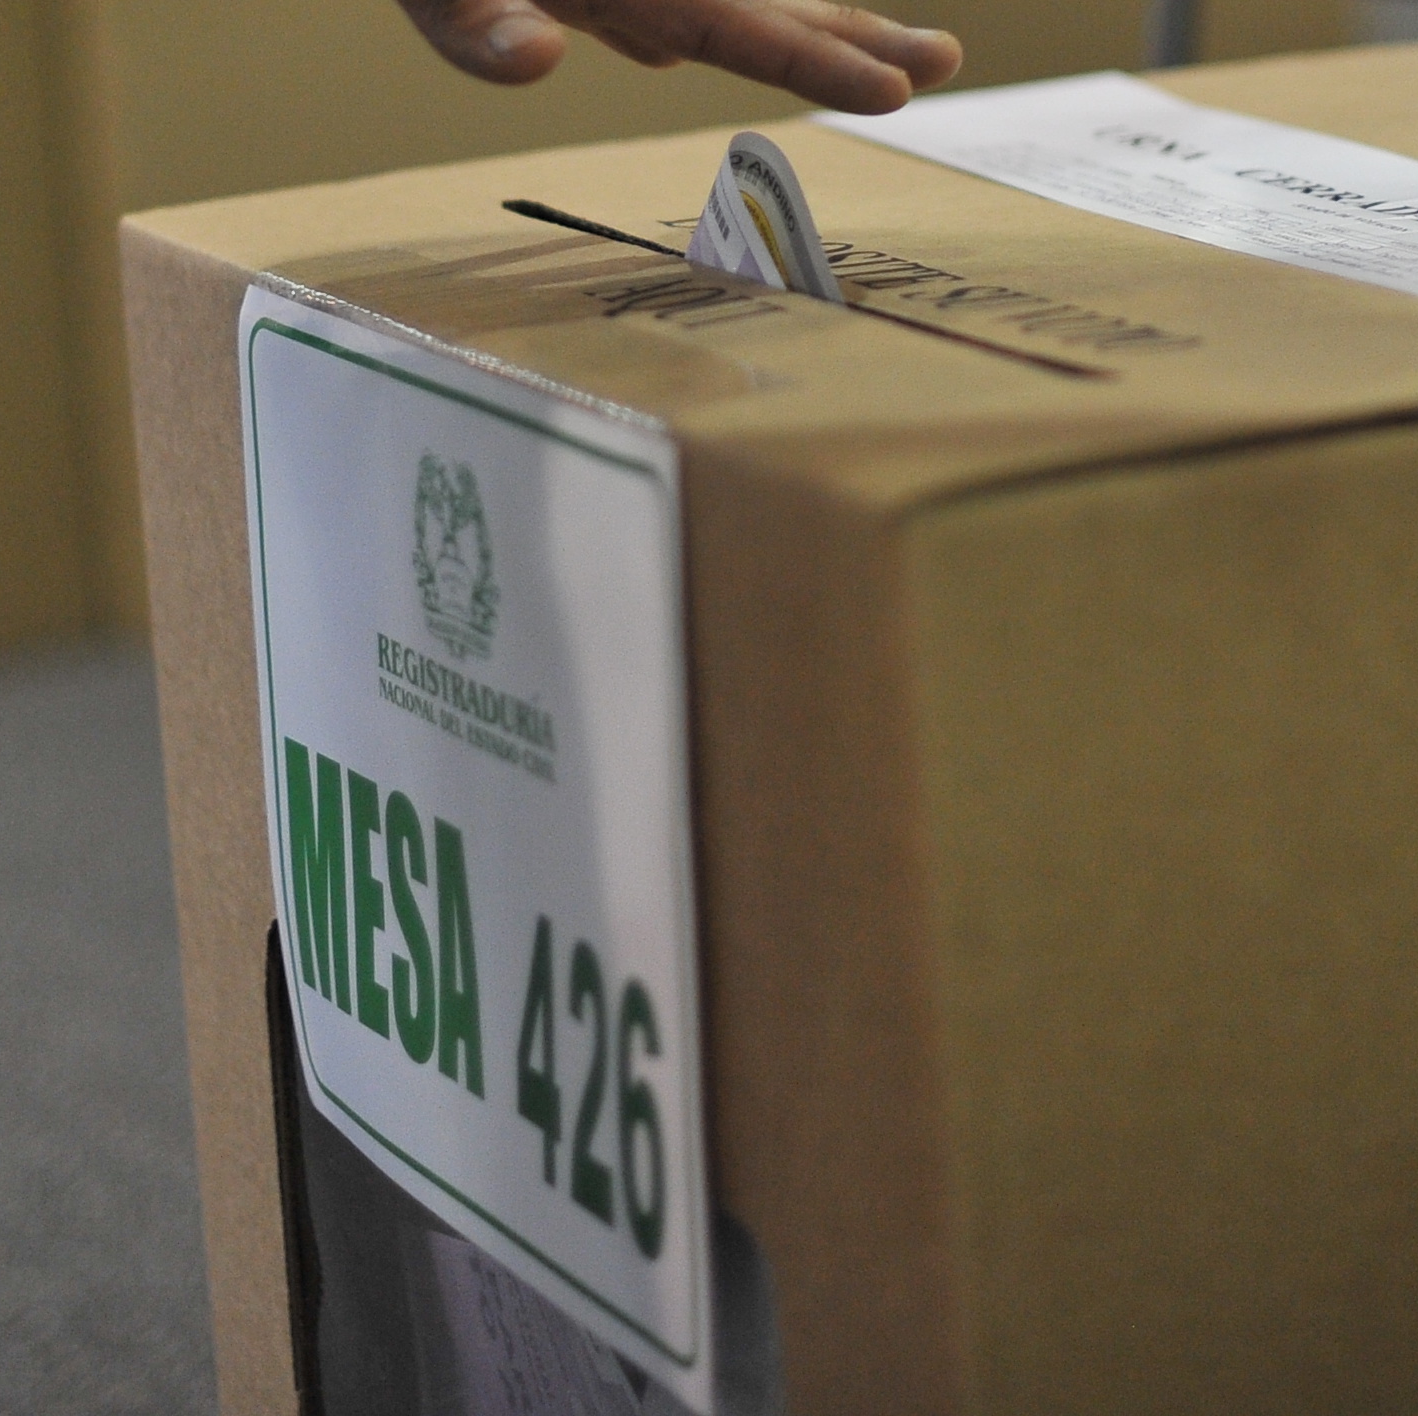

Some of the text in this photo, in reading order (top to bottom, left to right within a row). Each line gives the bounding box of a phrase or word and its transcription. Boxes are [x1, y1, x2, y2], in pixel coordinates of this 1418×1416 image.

[379, 675, 438, 727] NACIONAL
[284, 735, 668, 1264] MESA 426
